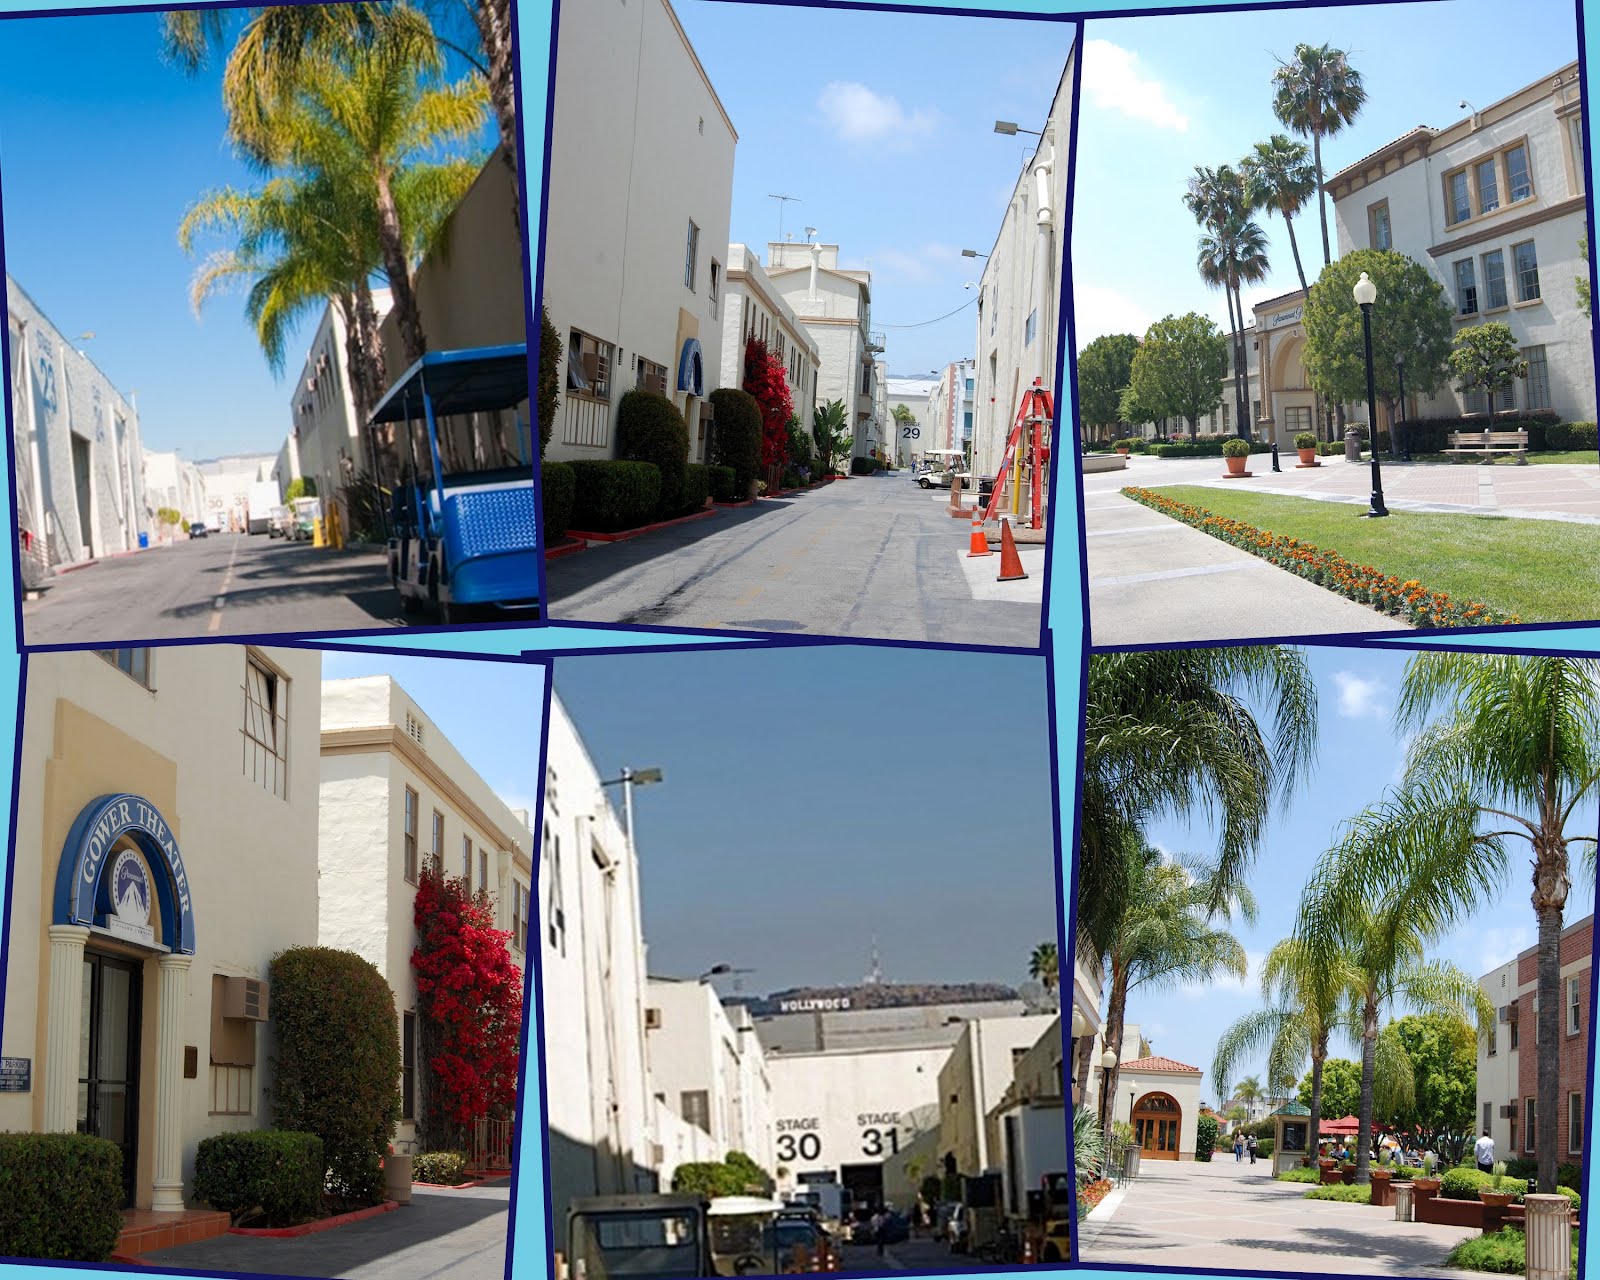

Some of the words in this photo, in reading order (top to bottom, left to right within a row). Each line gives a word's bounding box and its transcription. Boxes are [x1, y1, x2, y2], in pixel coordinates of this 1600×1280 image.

[40, 357, 57, 414] 23
[902, 427, 920, 439] 29
[209, 499, 223, 509] 30
[83, 802, 132, 883] GOWER
[136, 802, 190, 914] THEATER
[6, 1060, 28, 1069] PARKING
[776, 1118, 819, 1131] STAGE
[857, 1112, 901, 1126] STAGE
[777, 1133, 821, 1162] 30
[861, 1128, 900, 1156] 31
